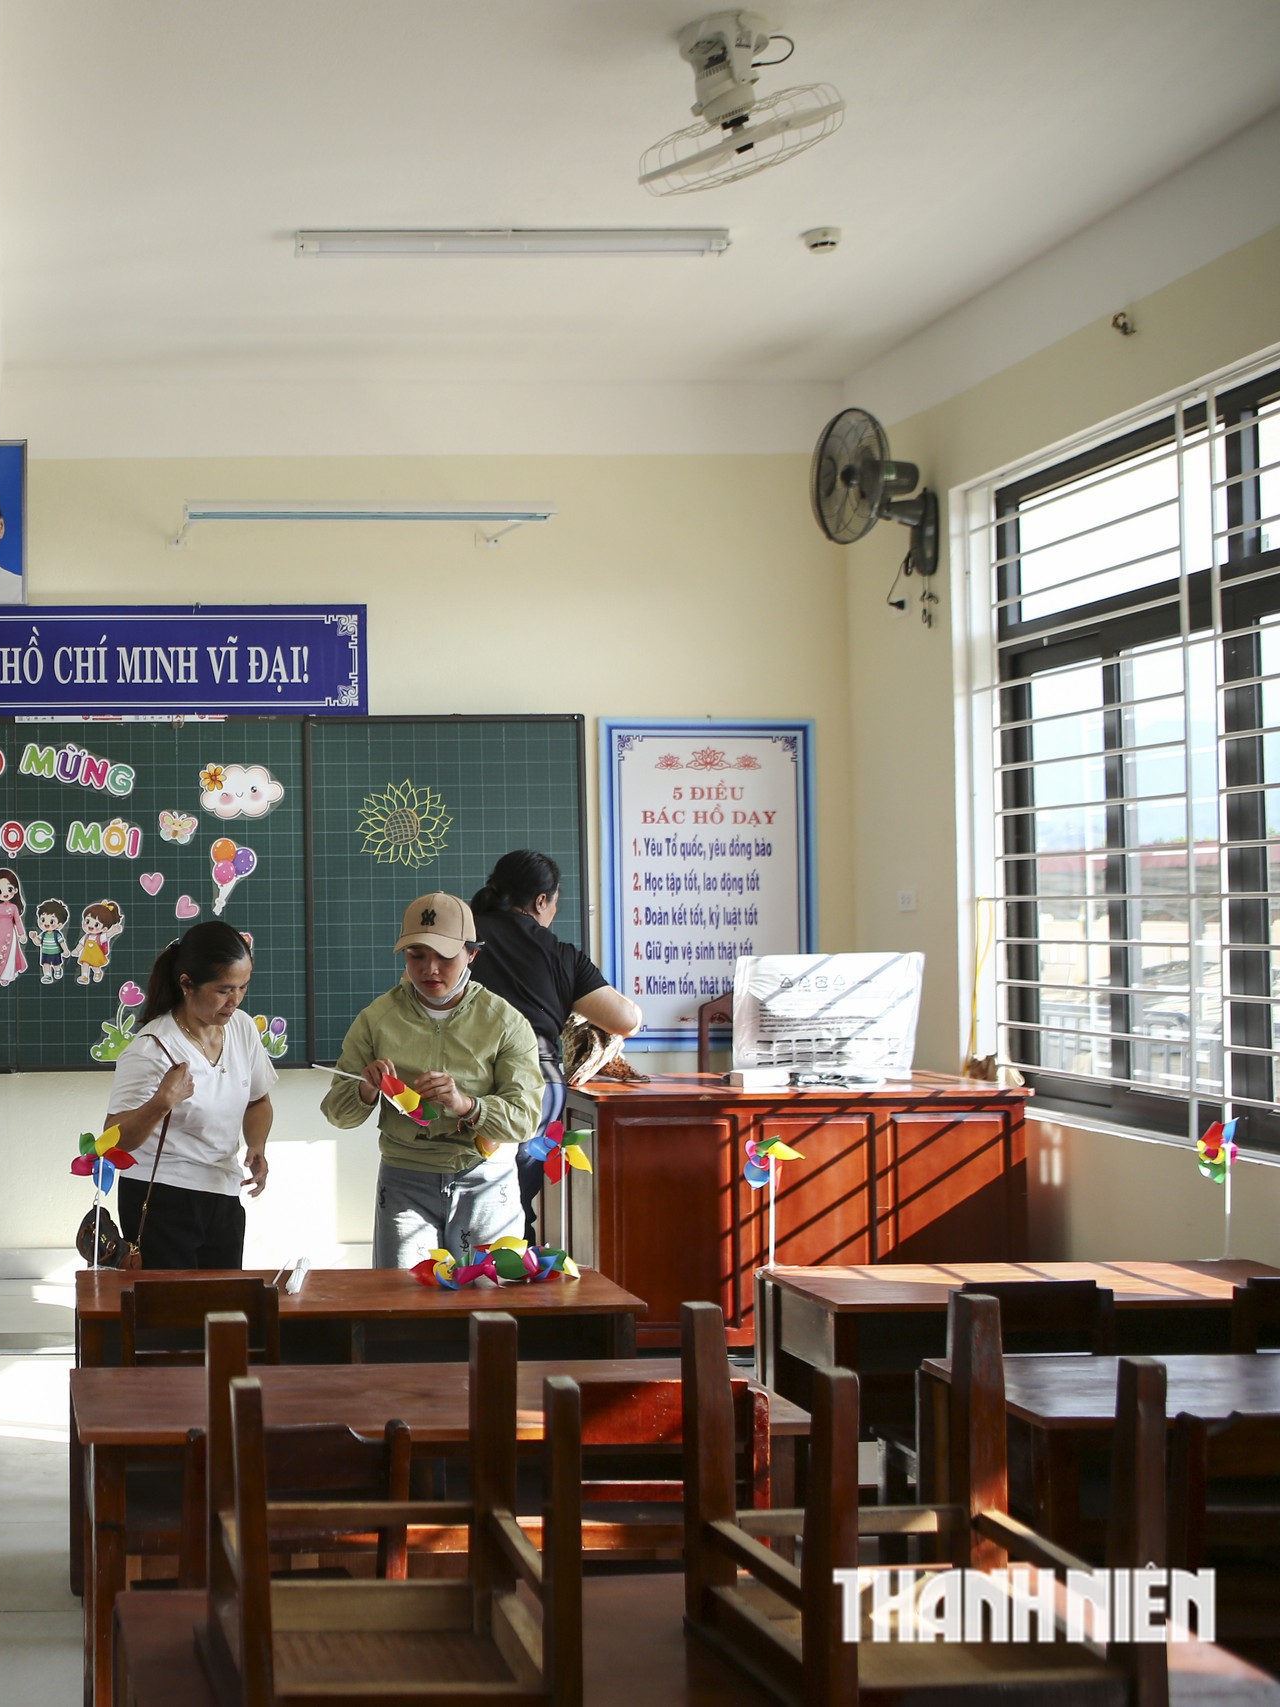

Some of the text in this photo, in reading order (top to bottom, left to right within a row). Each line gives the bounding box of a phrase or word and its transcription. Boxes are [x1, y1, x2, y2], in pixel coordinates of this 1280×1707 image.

[0, 626, 44, 684] HỒ
[54, 634, 108, 684] CHÍ
[117, 646, 198, 684] MINH
[207, 635, 239, 684] VĨ
[247, 645, 310, 693] ĐẠI!
[20, 743, 135, 796] MỪNG
[673, 780, 744, 800] 5 ĐIỀU
[641, 804, 776, 827] BÁC HỒ DẠY
[66, 818, 140, 858] MỚI
[633, 833, 772, 860] 1. Yêu Tổ quốc, yêu đồng bào
[633, 869, 760, 897] 2. Học tập tốt, lao động tốt
[634, 903, 758, 931] 3. Đoàn kết tốt, kỷ luật tốt
[634, 938, 753, 965] 4. Giữ gìn vệ sinh thật tốt
[634, 976, 643, 995] 5.
[646, 976, 676, 995] Khiêm
[679, 972, 697, 998] tốn,
[700, 976, 718, 1000] thật
